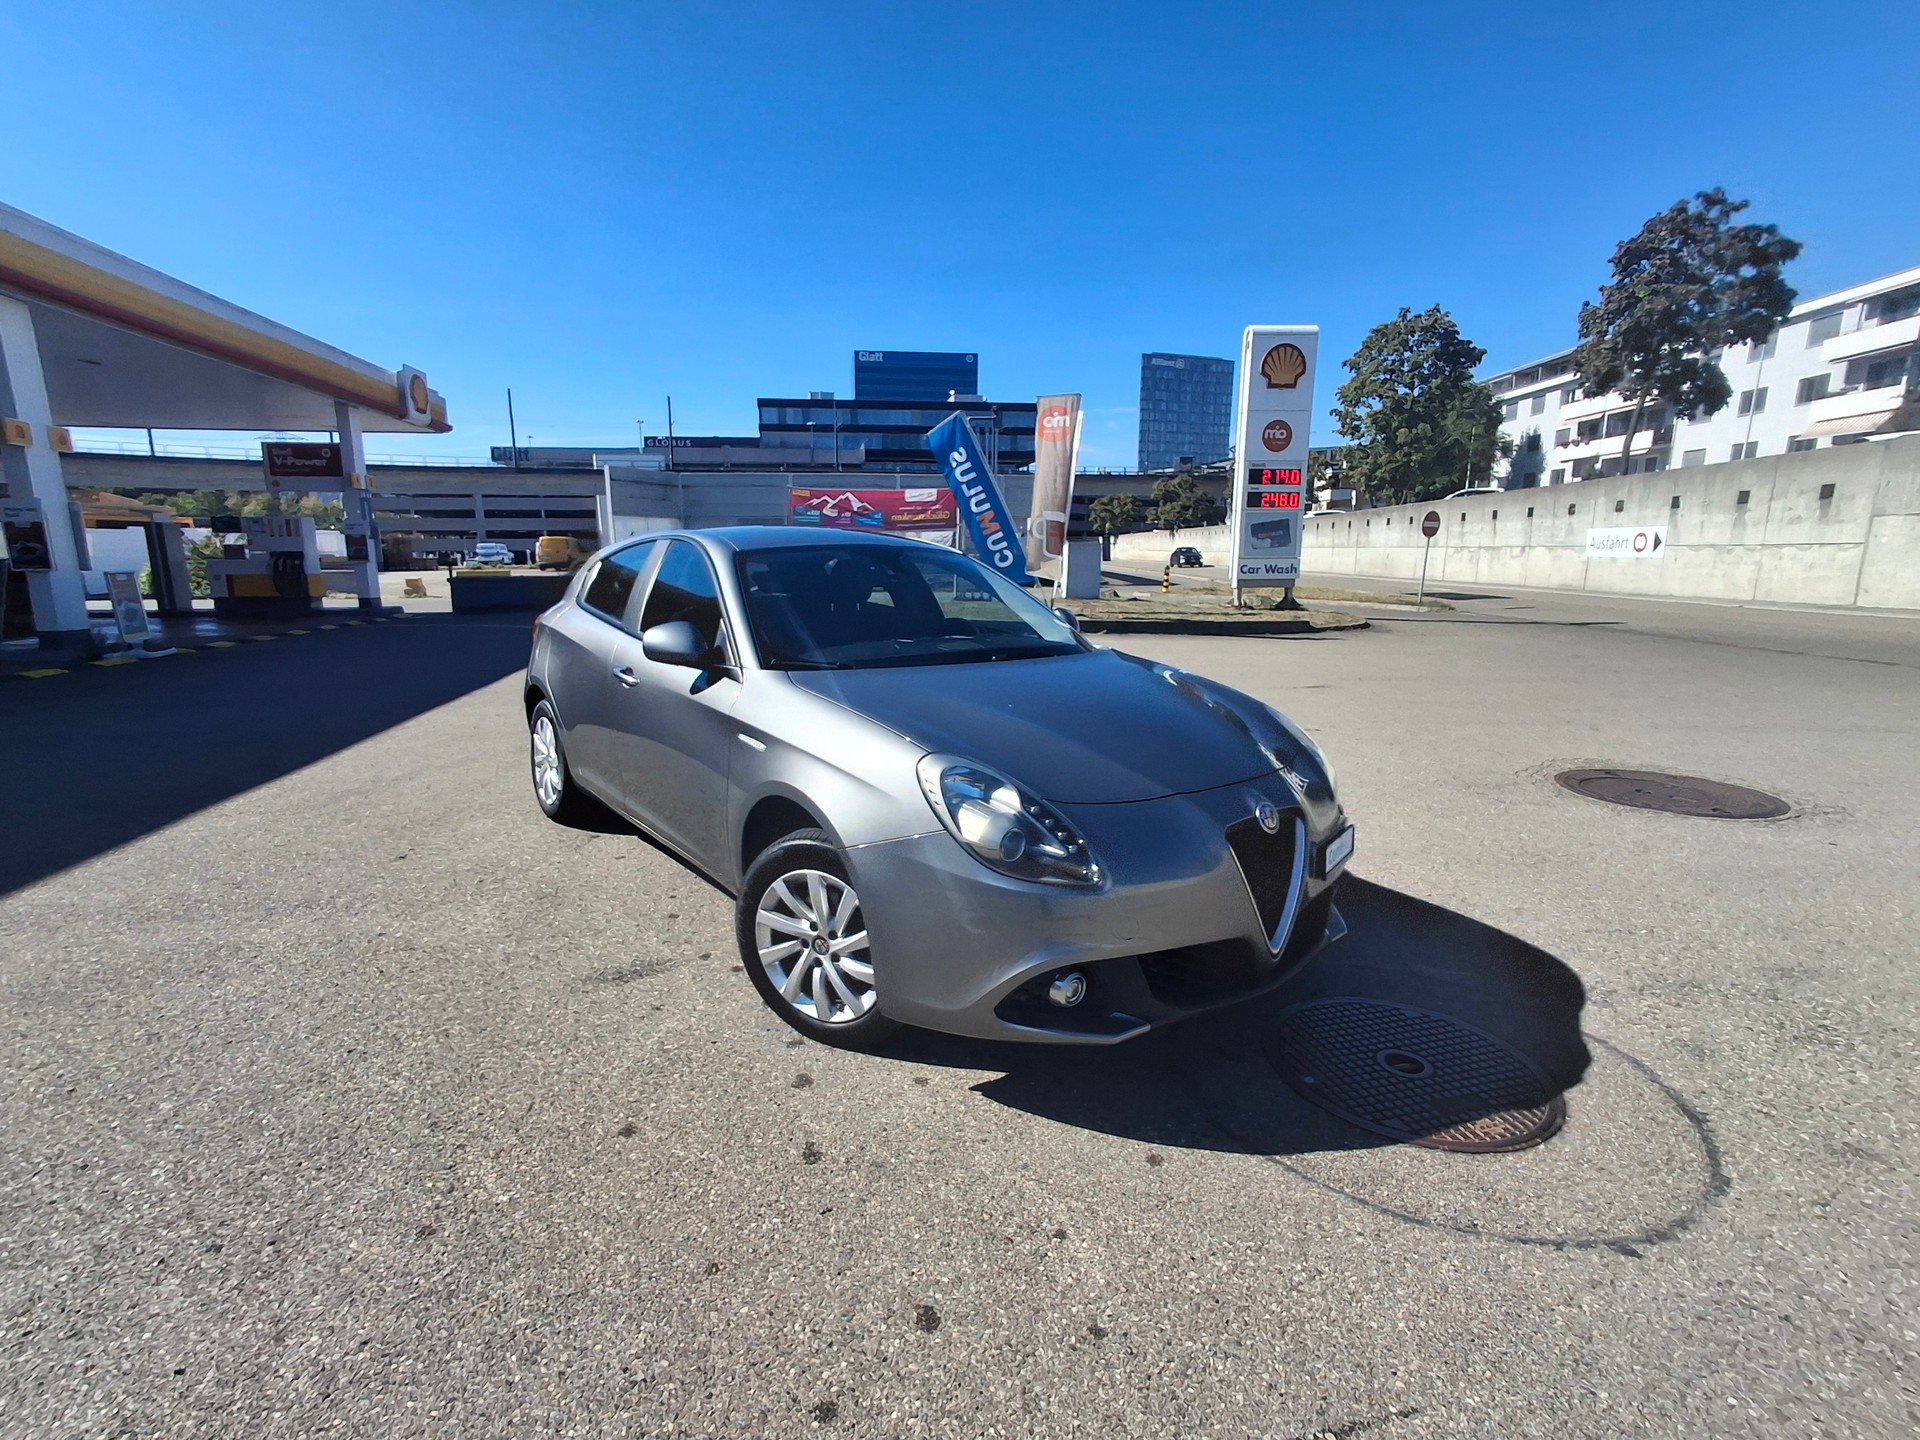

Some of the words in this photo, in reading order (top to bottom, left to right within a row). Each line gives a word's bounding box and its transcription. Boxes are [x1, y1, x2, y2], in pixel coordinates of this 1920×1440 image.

[858, 352, 883, 362] Glatt
[1264, 425, 1288, 440] mio
[272, 455, 329, 467] V-Power
[1260, 493, 1299, 508] 248.0
[1589, 535, 1629, 550] Ausfahrt
[1240, 564, 1261, 574] Car
[1264, 563, 1298, 575] Wash
